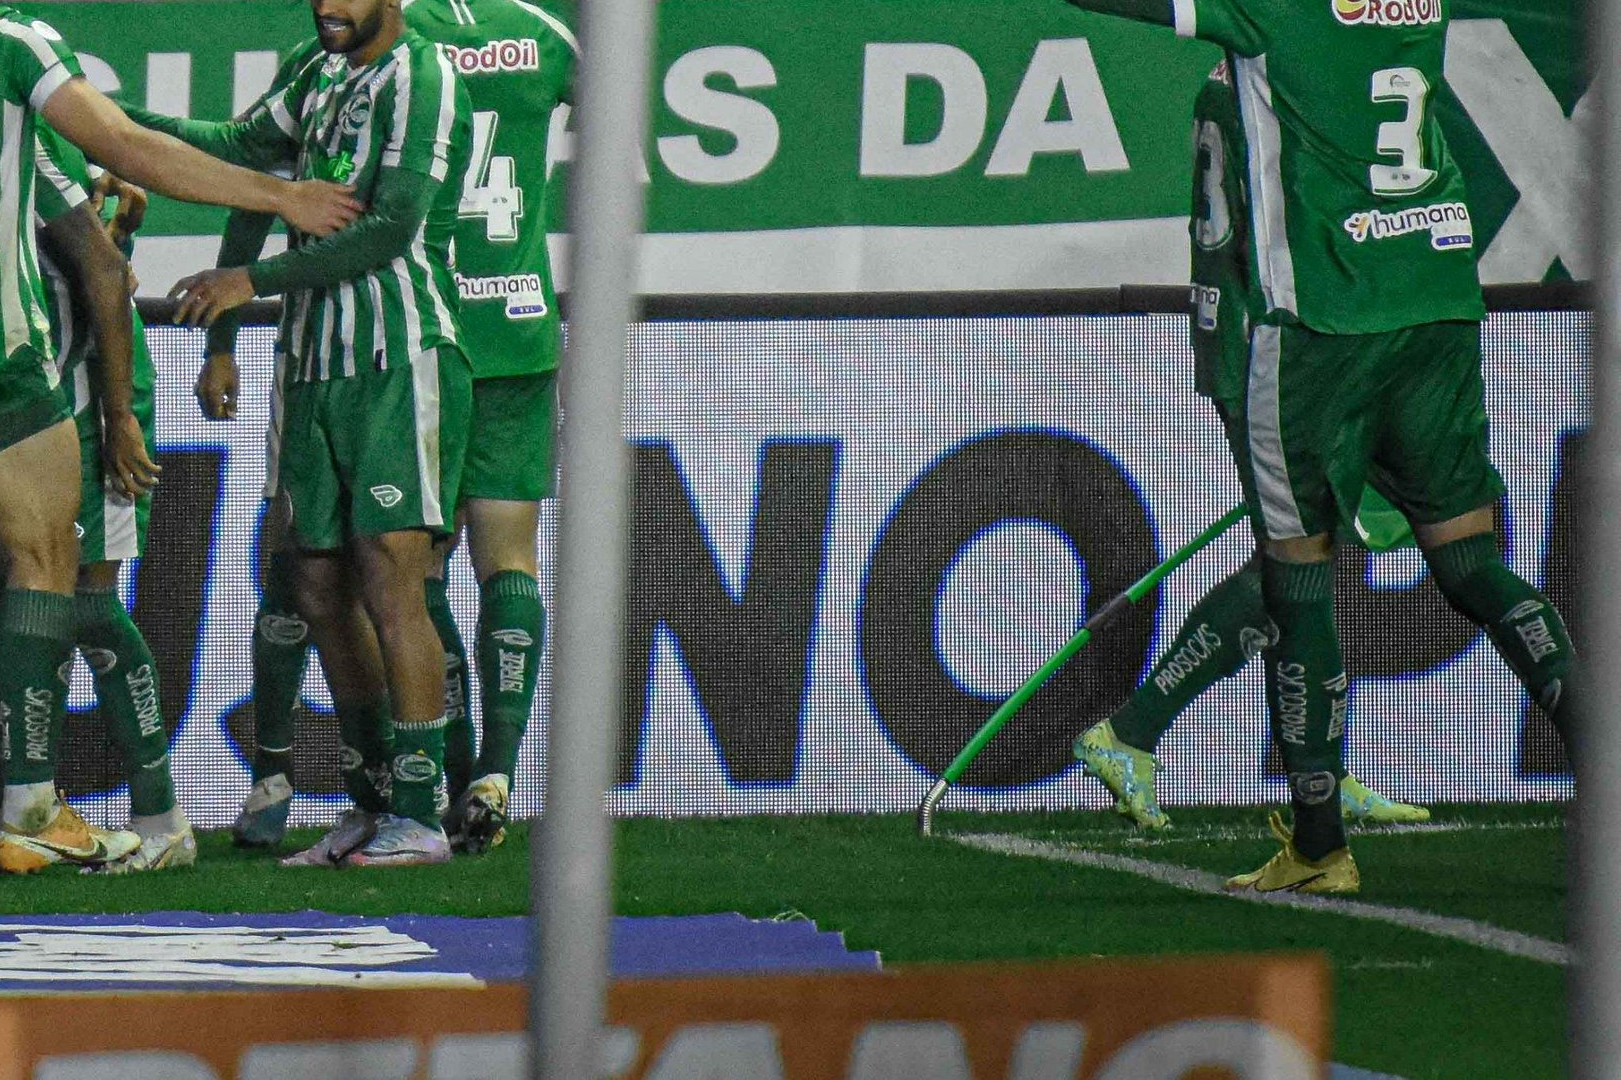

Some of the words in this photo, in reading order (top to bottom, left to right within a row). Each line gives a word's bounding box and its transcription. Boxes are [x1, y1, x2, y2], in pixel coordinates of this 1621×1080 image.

[859, 36, 1131, 179] DA
[1370, 67, 1438, 197] 3
[457, 110, 523, 242] 4
[1373, 205, 1468, 235] humana
[455, 276, 540, 297] humana
[612, 426, 1166, 791] NO
[1154, 623, 1223, 696] PROSOCKS
[25, 686, 53, 762] PROSOCKS
[125, 663, 163, 738] PROSOCKS
[1281, 661, 1307, 746] PROSOCKS
